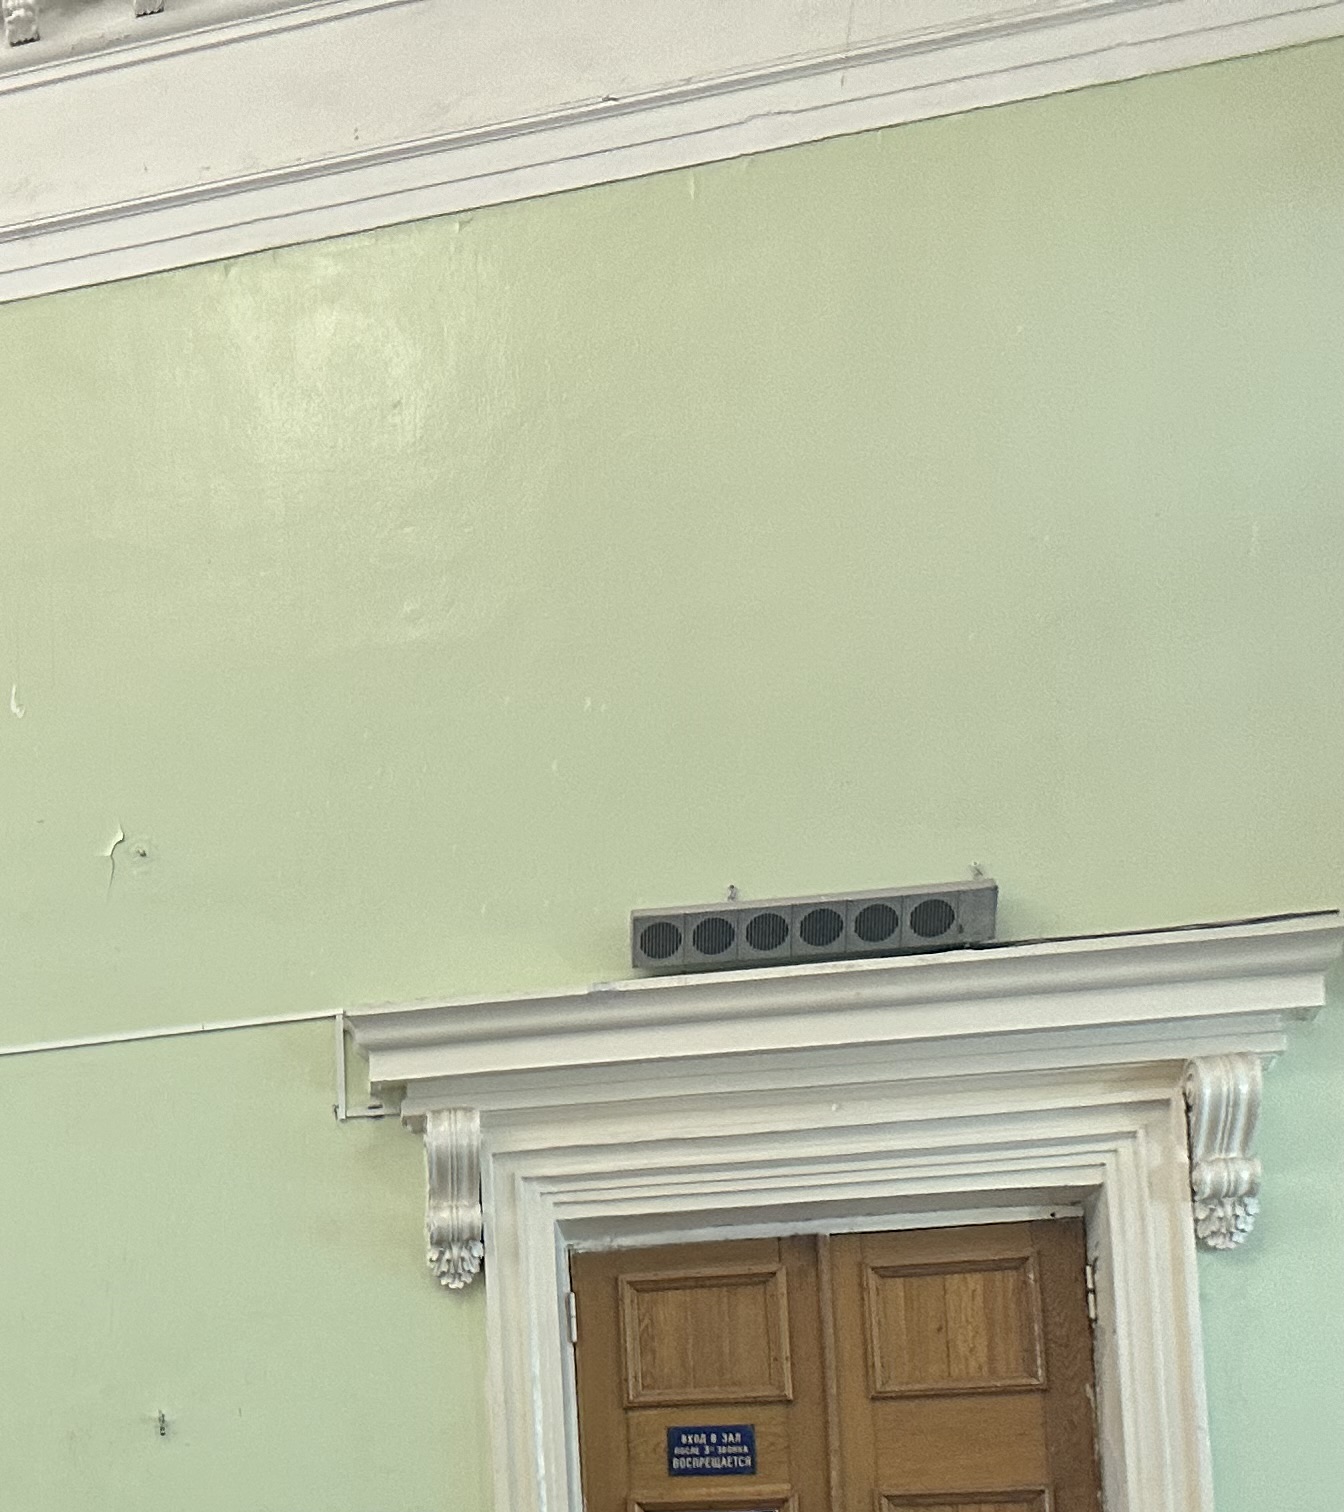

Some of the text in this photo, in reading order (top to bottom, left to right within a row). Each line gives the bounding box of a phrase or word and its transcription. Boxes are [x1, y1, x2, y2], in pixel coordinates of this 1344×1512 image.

[681, 1433, 742, 1445] ВХОД В ЗАЛ
[673, 1457, 752, 1469] ВОСПРЕЩАЕТСЯ
